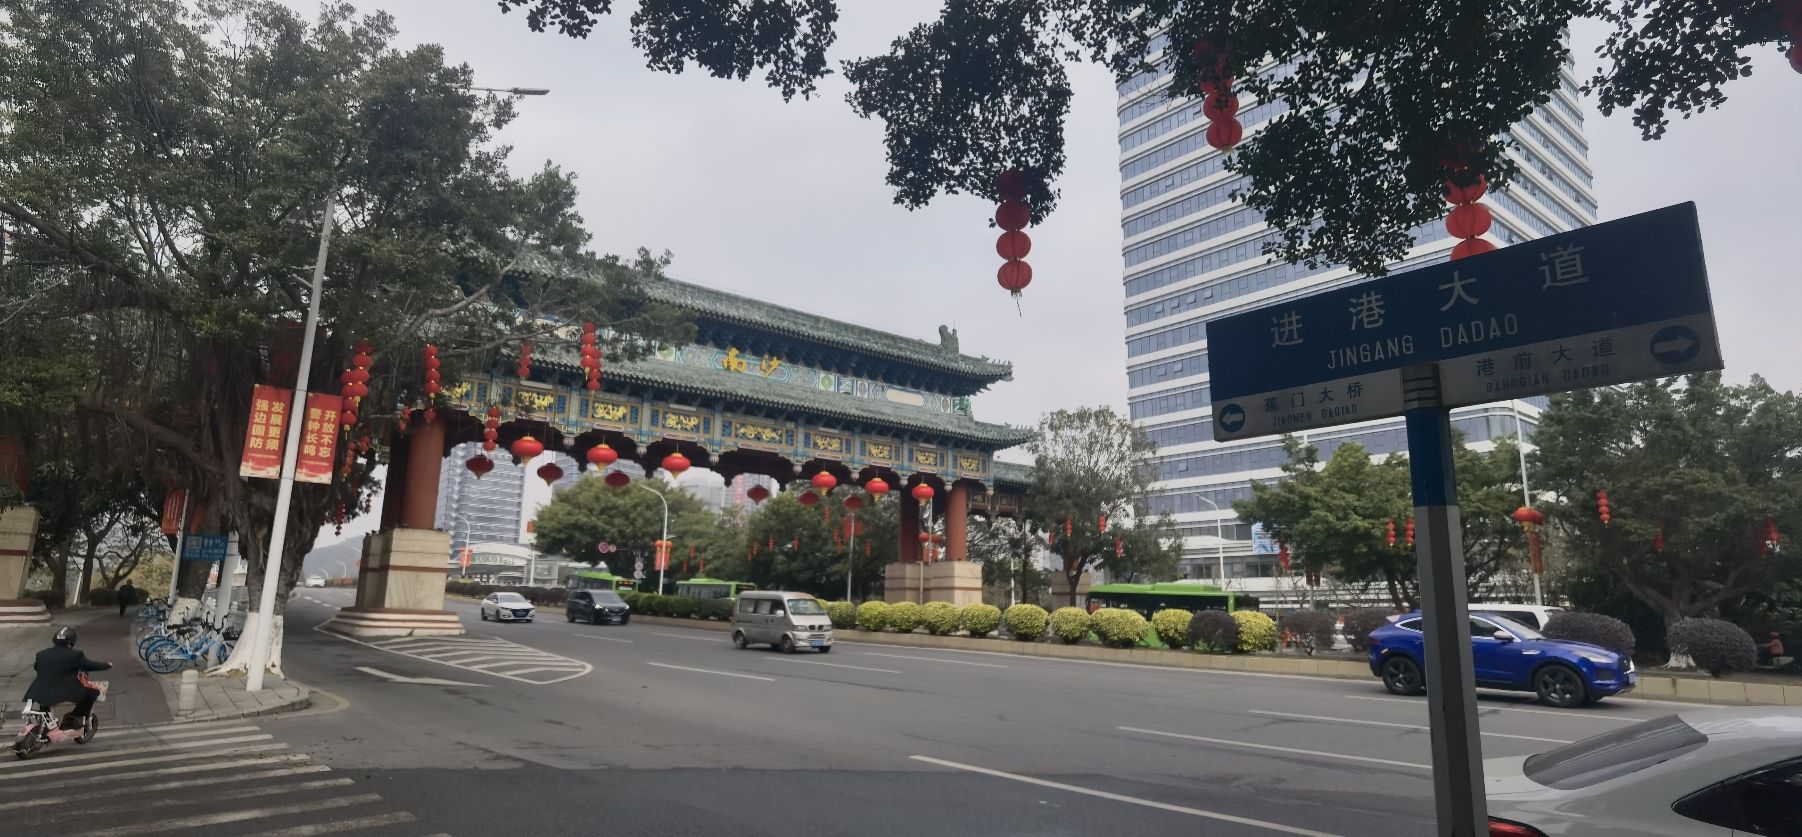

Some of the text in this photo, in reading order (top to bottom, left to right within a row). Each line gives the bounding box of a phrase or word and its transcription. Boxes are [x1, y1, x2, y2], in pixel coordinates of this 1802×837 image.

[1270, 242, 1590, 348] 进港大道
[1327, 314, 1519, 370] JINGANG DADAO
[1475, 336, 1617, 377] 港前大道
[1563, 363, 1609, 381] DADAO
[318, 410, 337, 458] 开放不忘
